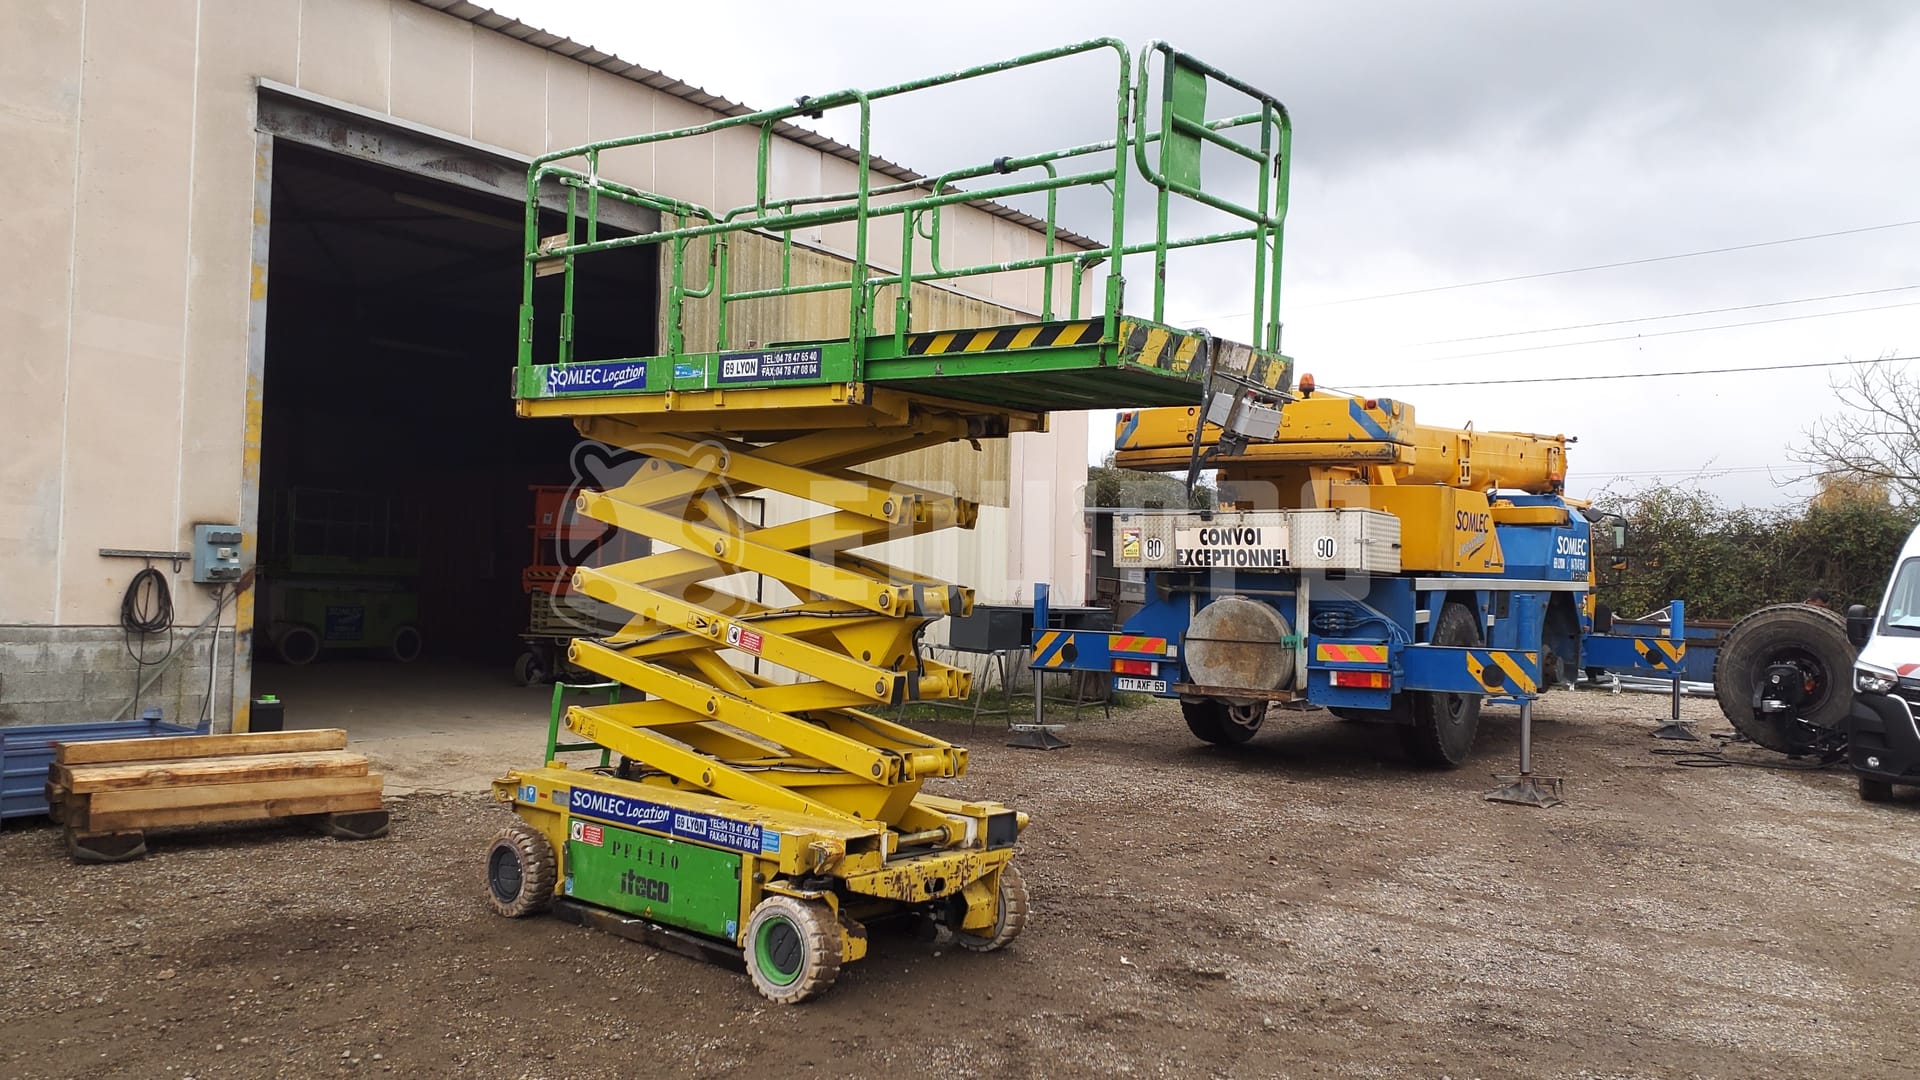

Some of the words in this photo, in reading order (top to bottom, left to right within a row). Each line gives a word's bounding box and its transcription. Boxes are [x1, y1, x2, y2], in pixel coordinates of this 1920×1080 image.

[792, 352, 801, 362] 47
[548, 368, 602, 387] SOMLEC
[602, 365, 645, 384] Location
[724, 362, 735, 376] 69
[736, 359, 757, 375] LYON
[792, 365, 801, 375] 47
[1456, 510, 1489, 533] SOMLEC
[1199, 528, 1262, 546] CONVOI
[1557, 535, 1587, 556] SOMLEC
[1147, 539, 1161, 558] 80
[1317, 538, 1334, 558] 90
[1176, 548, 1290, 567] EXCEPTIONNEL
[1121, 679, 1134, 689] 171
[1136, 680, 1152, 690] AXF
[1154, 681, 1165, 691] 69
[572, 790, 626, 817] SOMLEC
[626, 803, 670, 822] Location
[676, 815, 685, 829] 69
[686, 817, 705, 833] LYON
[736, 824, 743, 833] 47
[736, 836, 743, 847] 47
